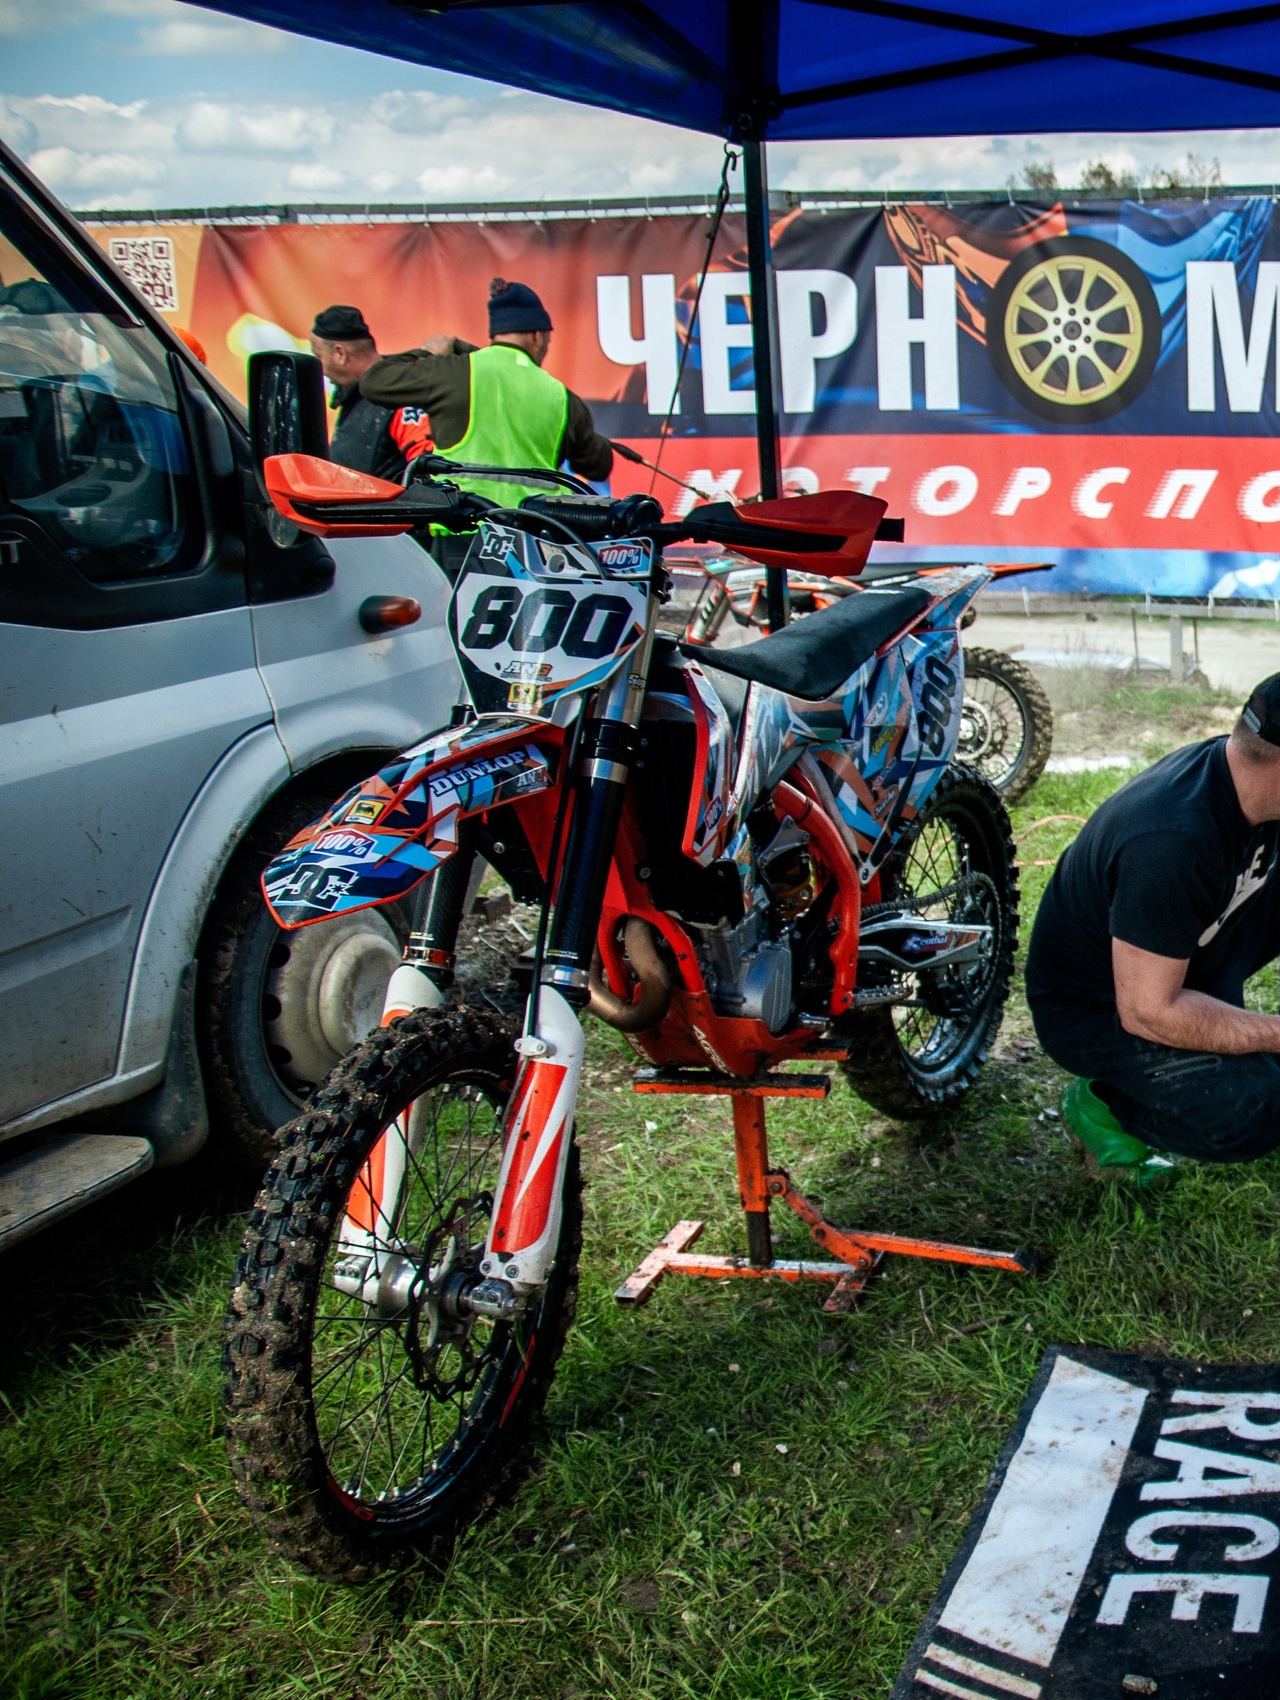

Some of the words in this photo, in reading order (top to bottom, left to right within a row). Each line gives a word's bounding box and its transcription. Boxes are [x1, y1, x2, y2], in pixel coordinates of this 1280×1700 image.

[597, 265, 960, 415] ЧЕРН
[601, 549, 640, 566] 100%
[460, 585, 633, 660] 800
[917, 655, 957, 758] 800
[428, 751, 527, 797] DUNLOP
[316, 833, 373, 856] 100%
[903, 935, 949, 951] Renthal
